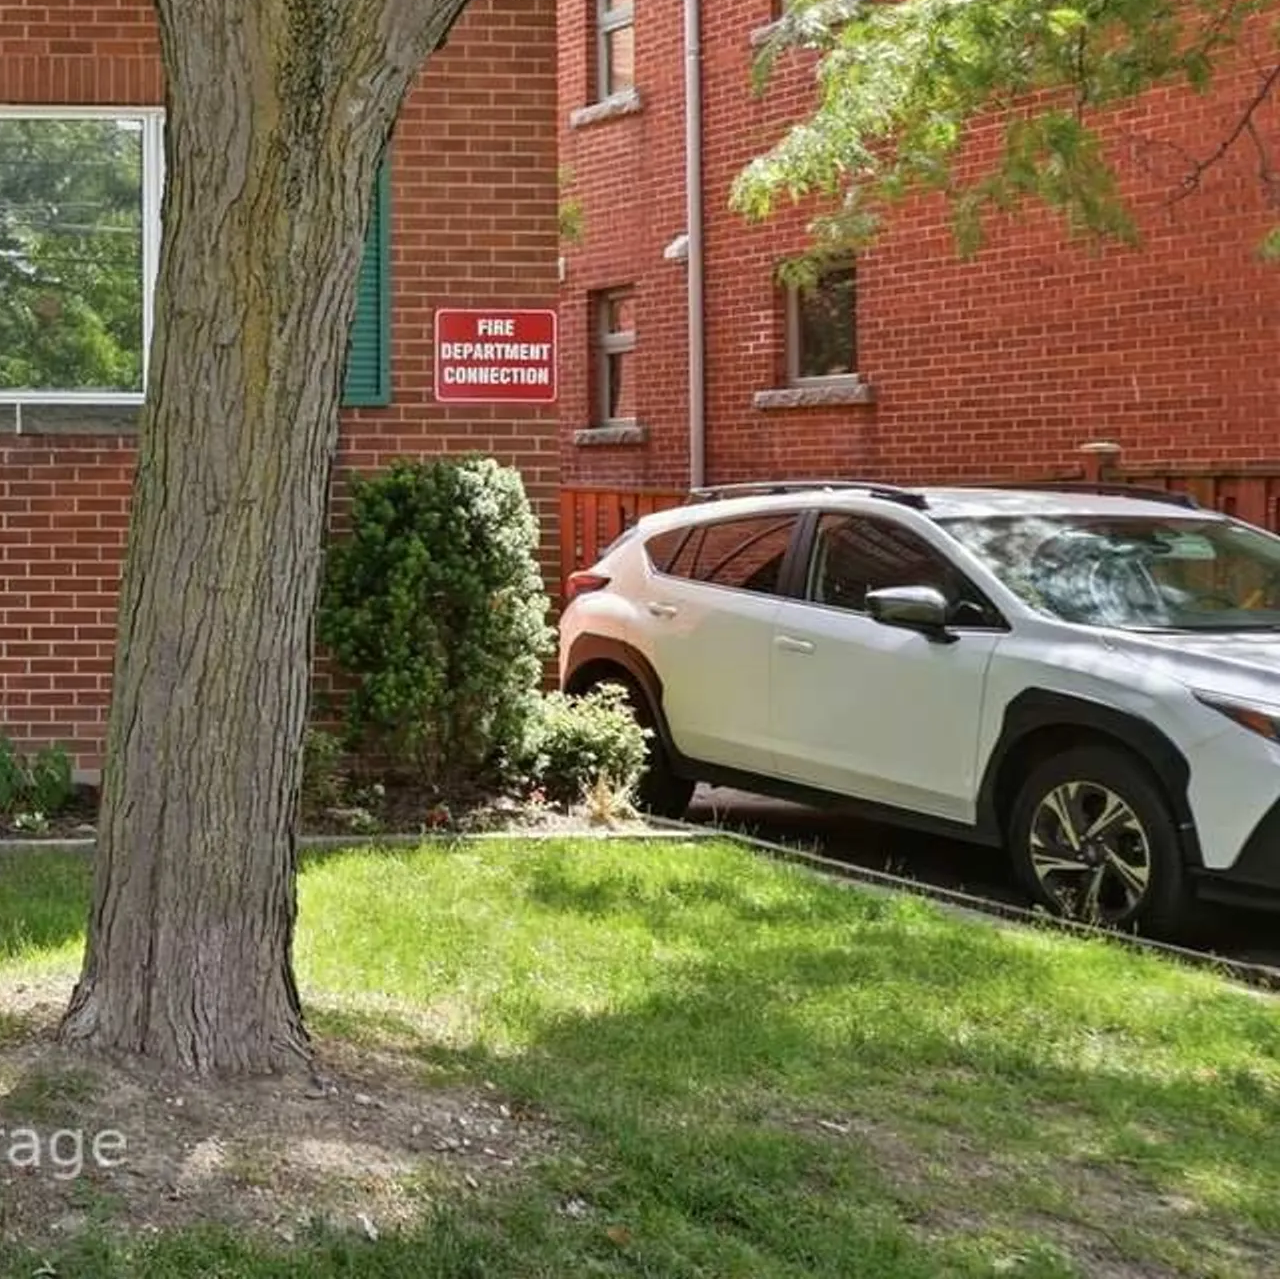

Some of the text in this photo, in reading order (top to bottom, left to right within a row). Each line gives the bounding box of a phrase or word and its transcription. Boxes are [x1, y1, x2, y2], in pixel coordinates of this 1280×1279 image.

[477, 319, 516, 336] FIRE
[441, 343, 551, 361] DEPARTMENT
[444, 367, 549, 385] CONNECTION
